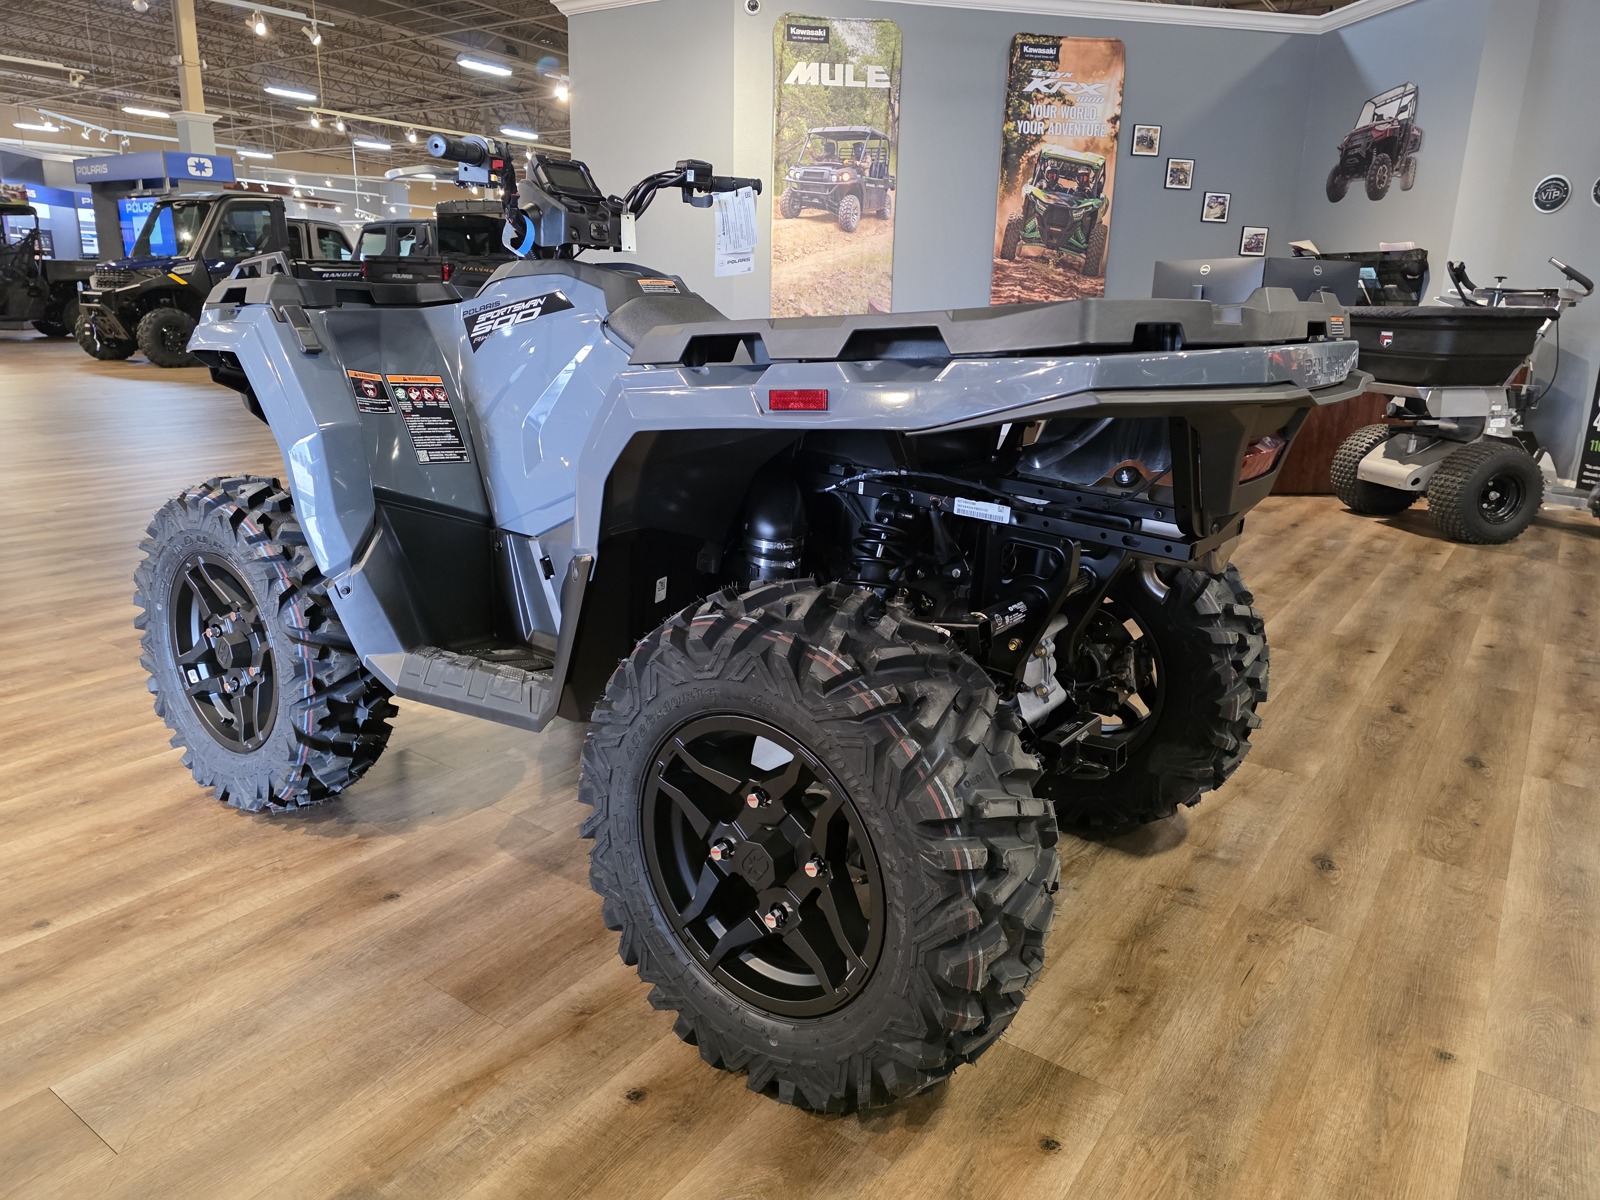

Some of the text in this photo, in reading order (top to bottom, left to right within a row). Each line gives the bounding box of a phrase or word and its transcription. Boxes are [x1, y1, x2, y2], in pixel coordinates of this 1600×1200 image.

[790, 26, 826, 36] Kawasaki
[1023, 45, 1057, 55] Kawasaki
[784, 61, 892, 89] MULE
[1022, 78, 1107, 96] KRX
[1076, 96, 1105, 104] 1000
[1030, 104, 1099, 120] YOUR WORLD.
[1017, 120, 1108, 137] YOUR ADVENTURE.
[76, 163, 109, 176] POLARIS
[1541, 190, 1560, 200] VIP
[727, 257, 751, 265] POLARIS
[462, 301, 501, 317] POLARIS
[476, 297, 547, 323] SPORTSMAN
[470, 307, 542, 338] 500
